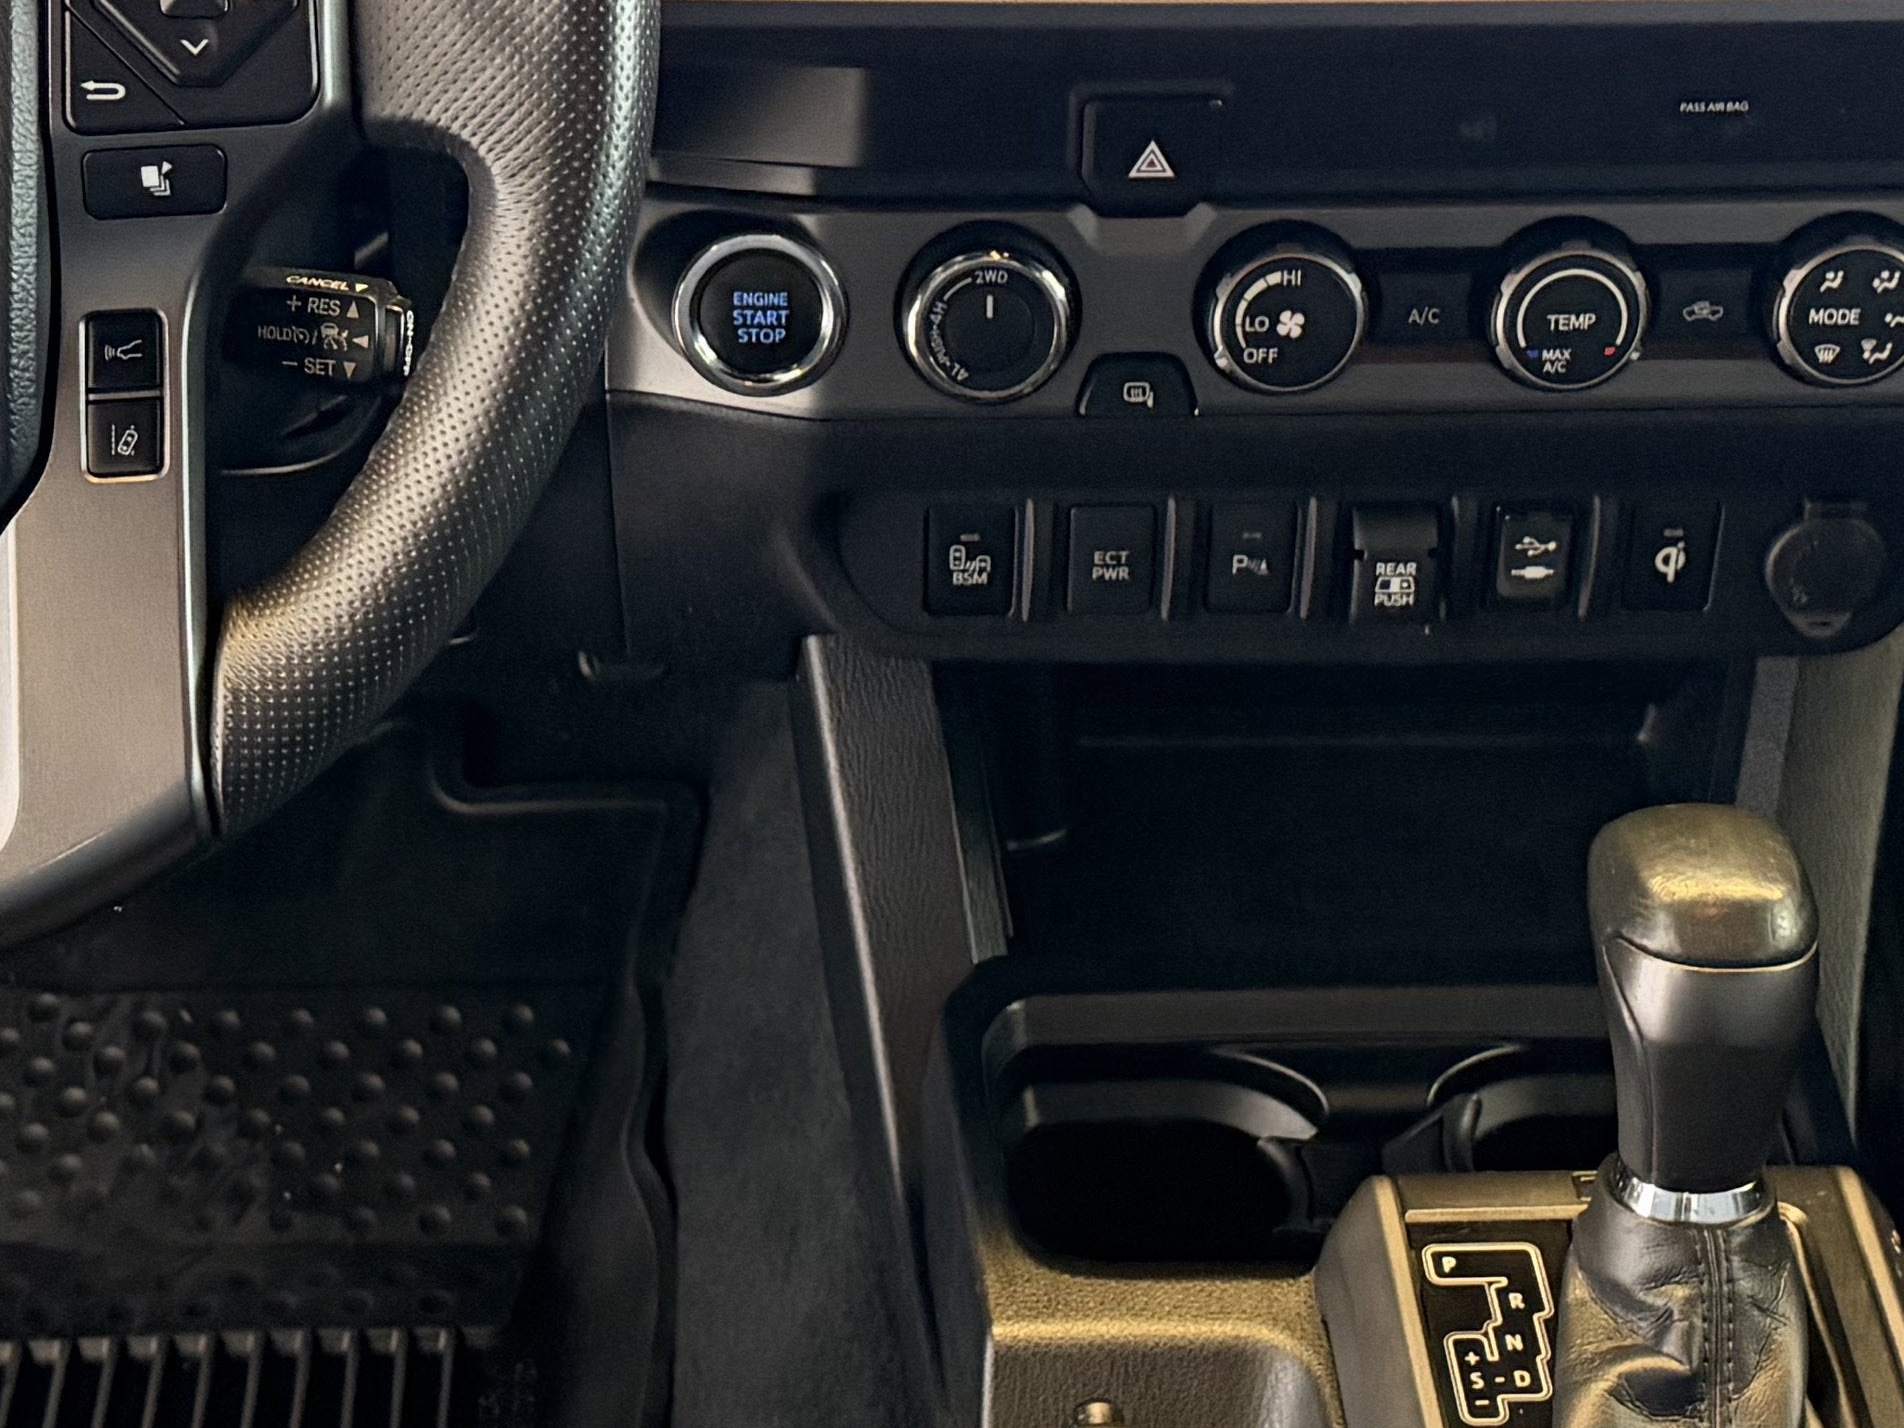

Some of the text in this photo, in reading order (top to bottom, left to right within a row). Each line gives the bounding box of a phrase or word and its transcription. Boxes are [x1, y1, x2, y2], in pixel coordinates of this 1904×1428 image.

[285, 275, 350, 291] CANCEL
[974, 269, 1008, 285] 2WD
[1282, 269, 1302, 287] HI
[307, 296, 341, 317] RES
[732, 291, 788, 306] ENGINE
[732, 308, 790, 326] START
[1245, 315, 1270, 333] LO
[1408, 305, 1441, 327] A/C
[1546, 313, 1596, 332] TEMP
[1808, 307, 1862, 326] MODE
[257, 324, 292, 342] HOLD
[737, 327, 787, 344] STOP
[1243, 347, 1279, 365] OFF
[1541, 348, 1572, 361] MAX
[304, 356, 337, 377] SET
[1542, 360, 1567, 374] A/C
[1093, 550, 1130, 565] ECT
[1091, 565, 1130, 581] PWR
[1375, 561, 1418, 576] REAR
[952, 571, 988, 586] BSM
[1374, 593, 1415, 607] PUSH
[1441, 1256, 1457, 1273] P
[1507, 1292, 1526, 1310] R
[1504, 1333, 1524, 1352] N
[1470, 1369, 1532, 1390] S D
